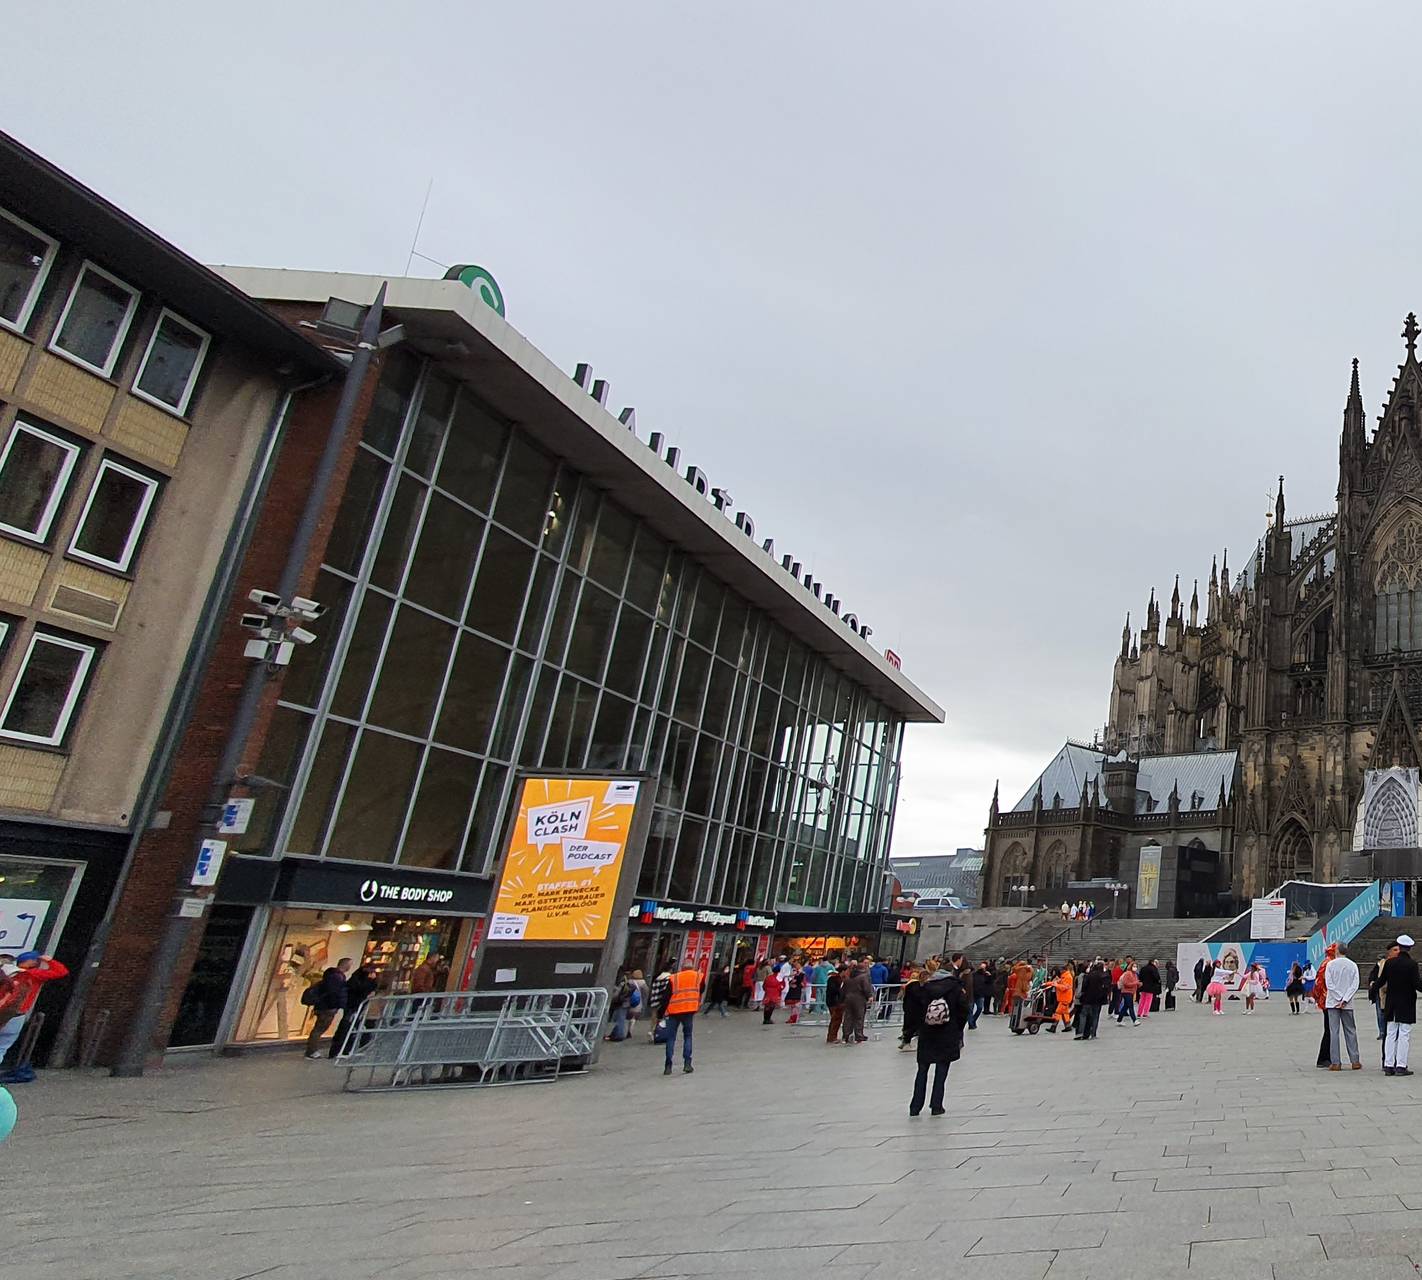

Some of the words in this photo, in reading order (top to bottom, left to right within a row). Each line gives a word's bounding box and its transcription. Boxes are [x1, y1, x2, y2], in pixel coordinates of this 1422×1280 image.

[535, 810, 582, 827] KÖLN
[534, 823, 578, 837] CLASH
[380, 885, 400, 899] THE
[401, 887, 428, 900] BODY
[427, 888, 453, 902] SHOP
[538, 889, 560, 897] MARK
[563, 886, 600, 894] BENECKE
[1329, 894, 1375, 944] CULTURALIS
